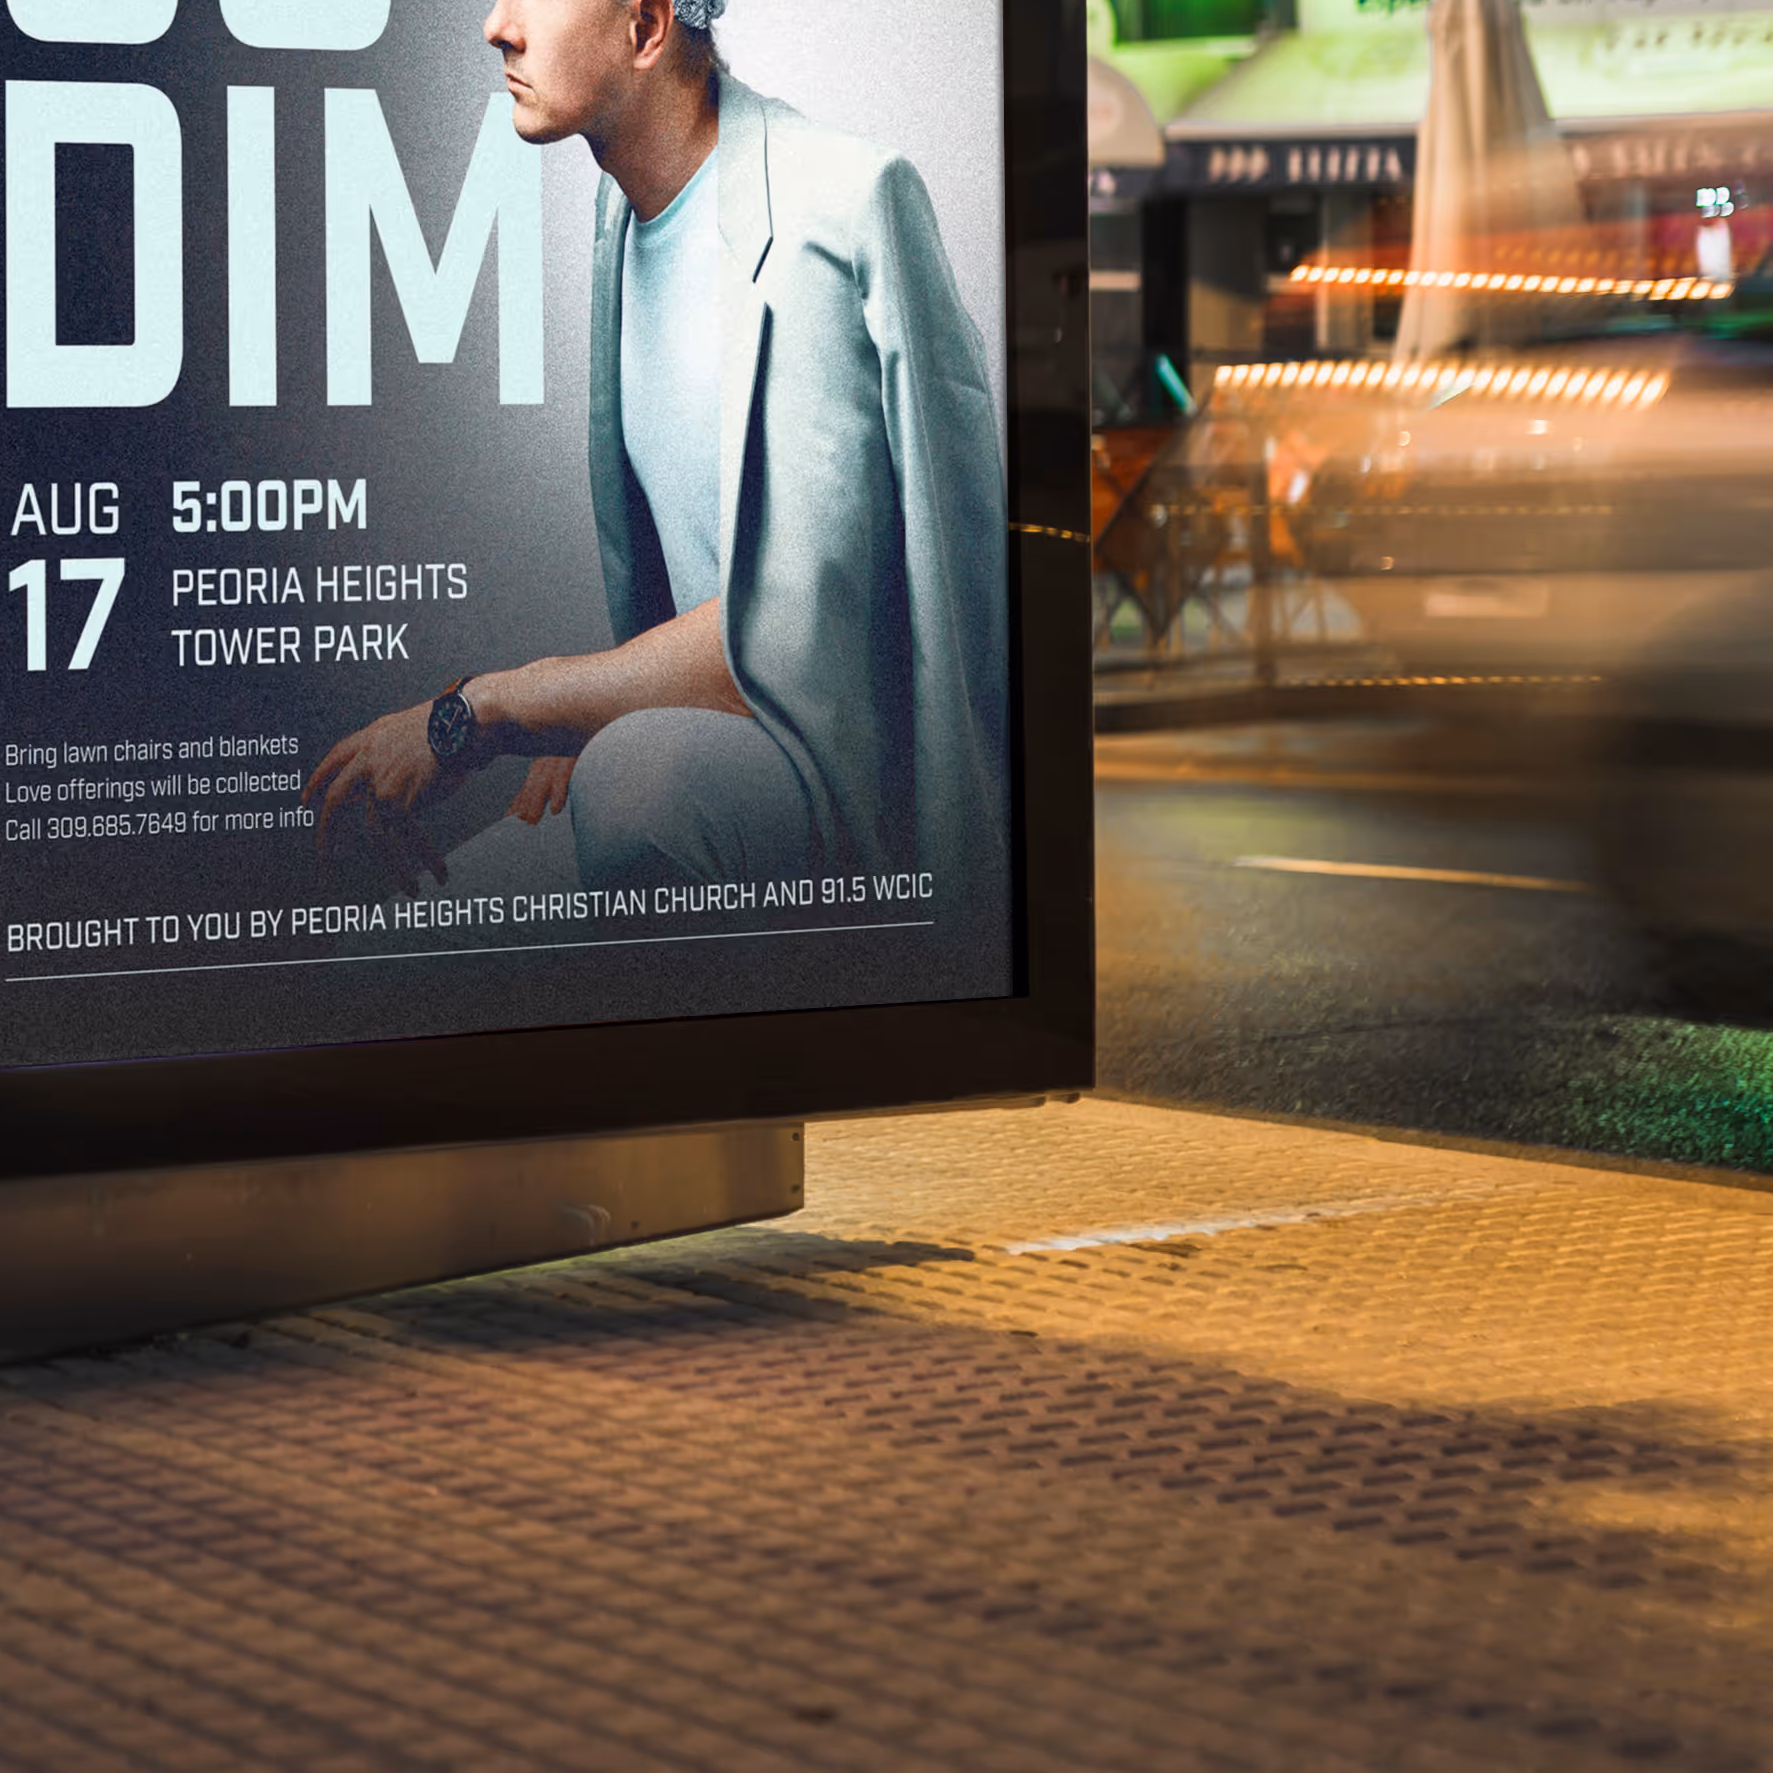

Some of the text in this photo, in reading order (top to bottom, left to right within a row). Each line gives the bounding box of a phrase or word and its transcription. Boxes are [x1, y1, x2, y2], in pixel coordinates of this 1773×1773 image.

[6, 79, 545, 408] DIM
[10, 481, 120, 536] AUG
[172, 478, 367, 534] 5:00PM
[172, 562, 468, 607] PEORIA HEIGHTS
[8, 556, 126, 672] 17
[171, 622, 410, 667] TOWER PARK
[5, 734, 299, 770] Bring lawn chairs and blankets
[5, 769, 301, 804] Love offerings will be collected
[5, 805, 315, 842] Call 309.685.7649 for more info
[7, 872, 934, 953] BROUGHT TO YOU BY PEORIA HEIGHTS CHRISTIAN CHURCH AND 91.5 WCIC
